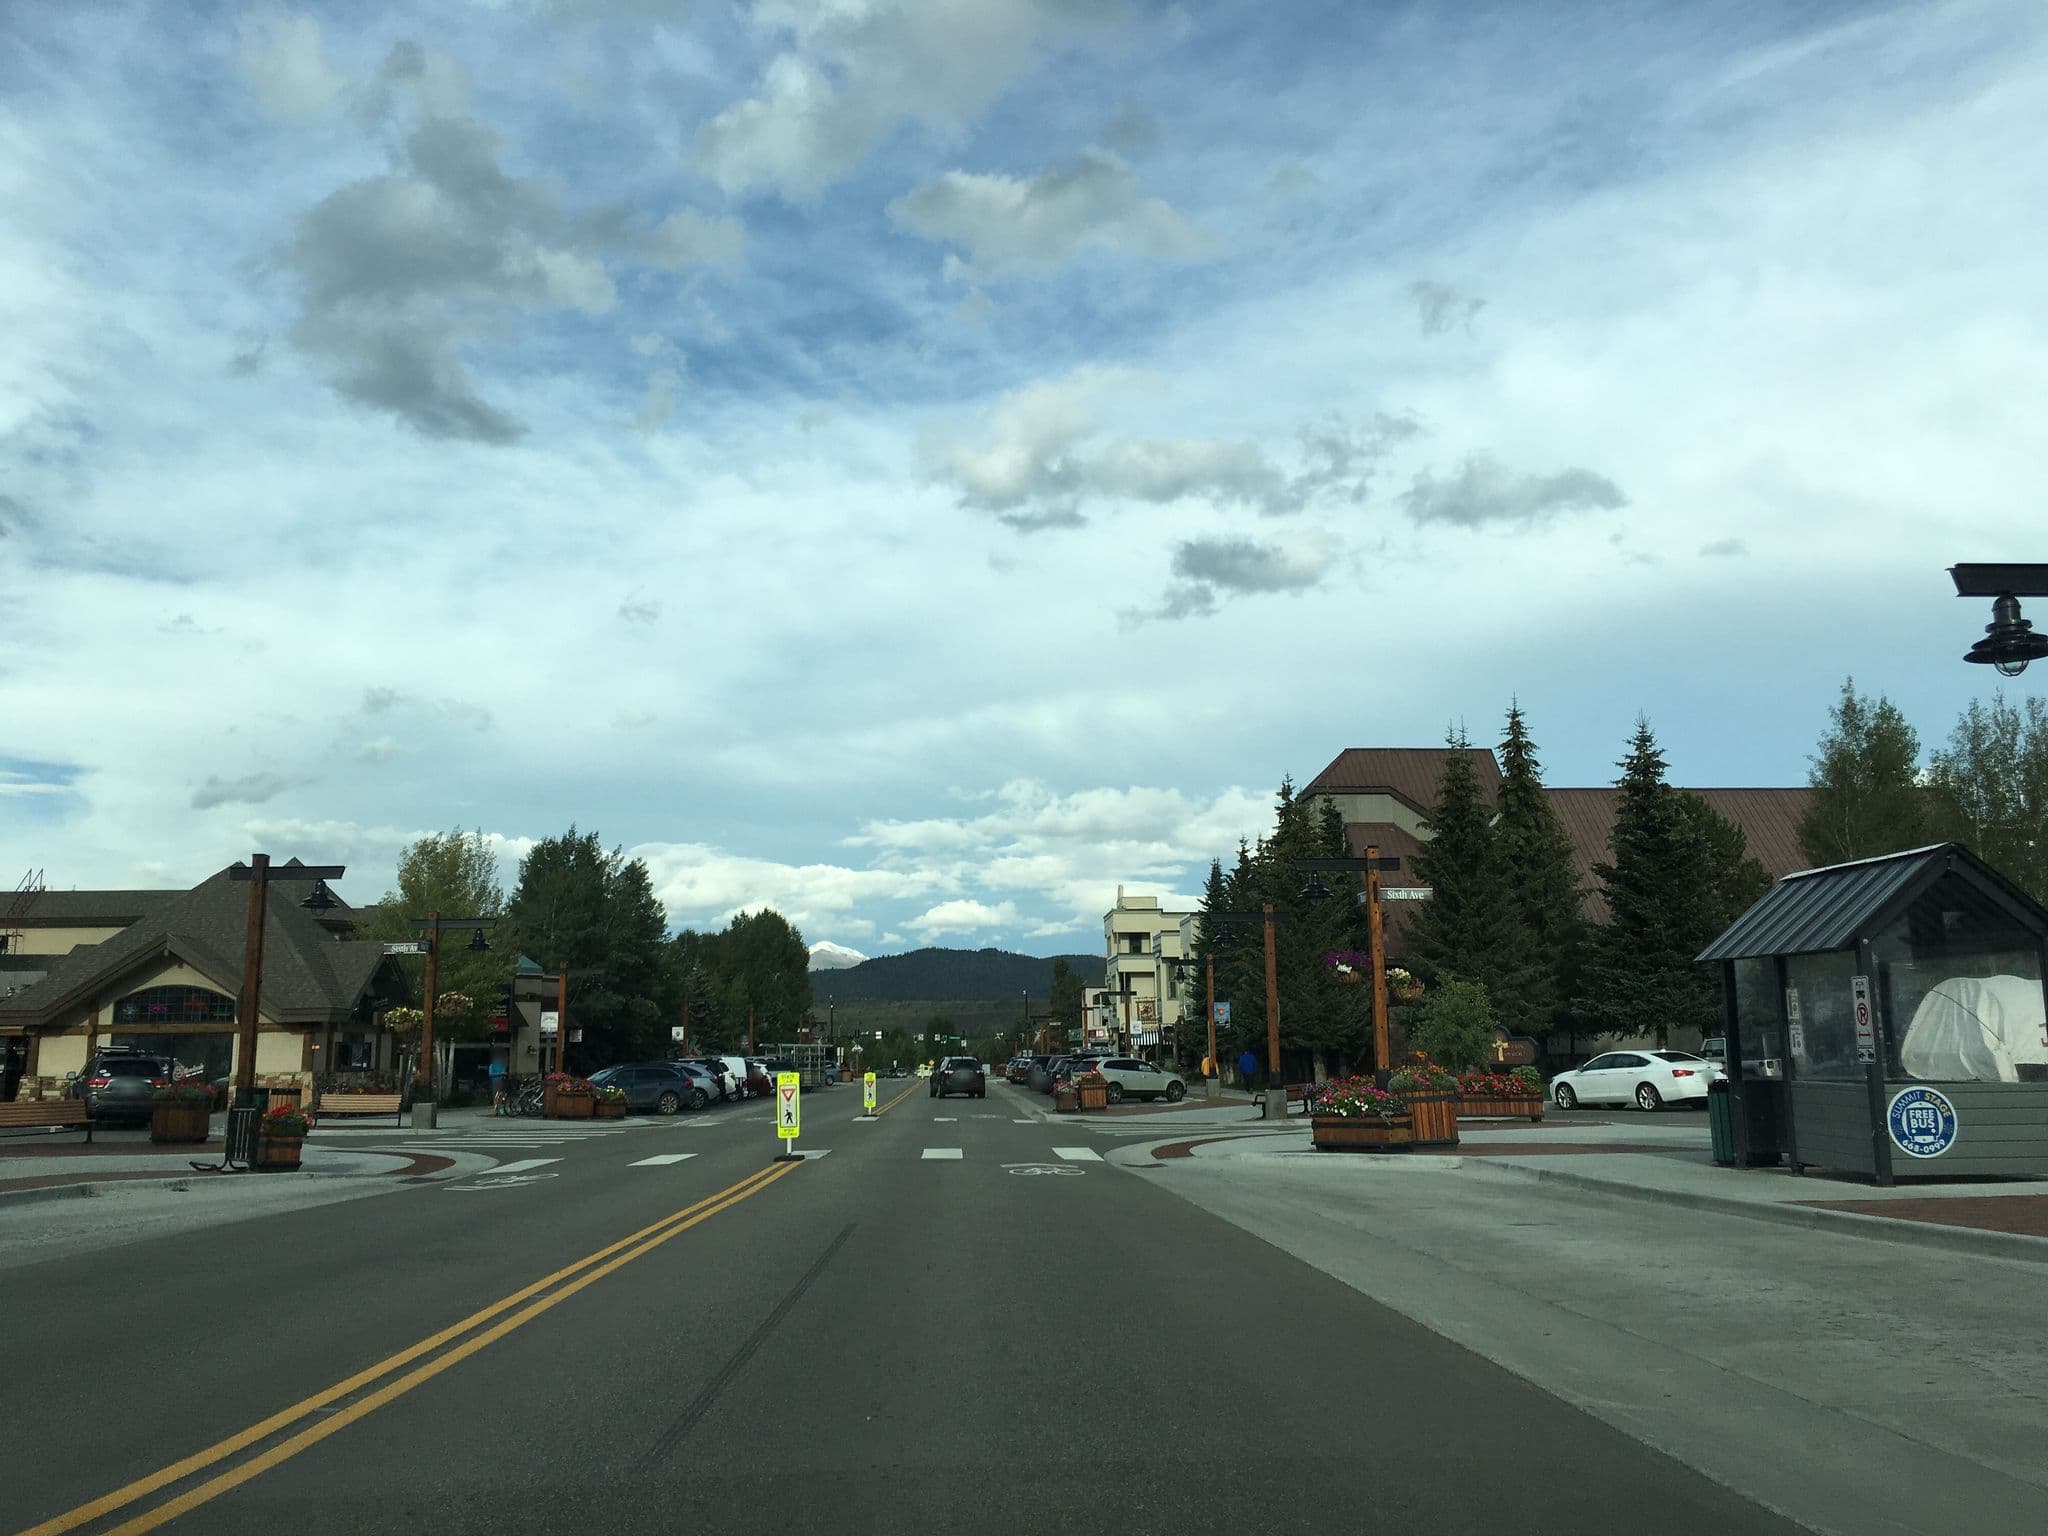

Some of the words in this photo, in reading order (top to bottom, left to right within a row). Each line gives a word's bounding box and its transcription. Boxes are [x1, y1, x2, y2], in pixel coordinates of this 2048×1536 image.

[1387, 890, 1408, 900] Sixth
[1409, 890, 1424, 900] Ave
[1892, 1091, 1920, 1118] SUMMIT
[1924, 1092, 1952, 1117] STAGE
[1909, 1109, 1935, 1118] FREE
[1910, 1119, 1935, 1128] BUS
[1902, 1139, 1945, 1153] 668-0999
